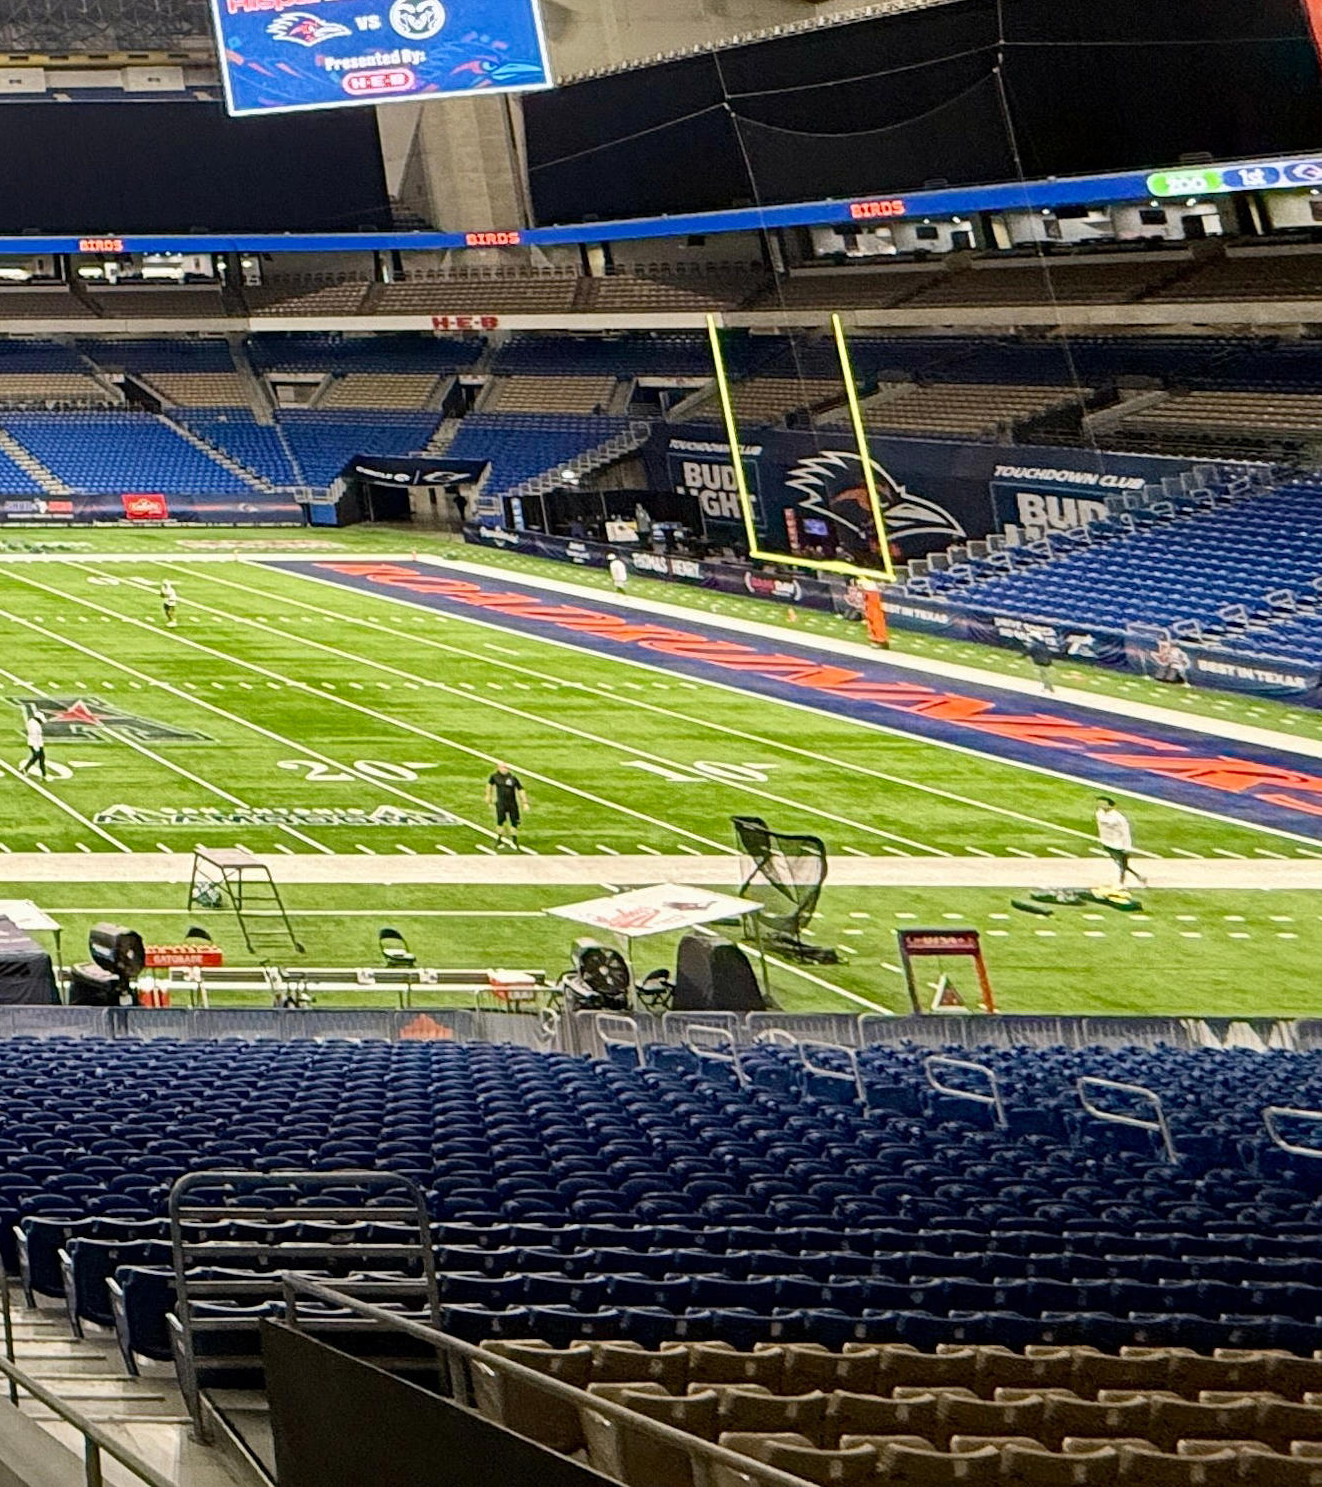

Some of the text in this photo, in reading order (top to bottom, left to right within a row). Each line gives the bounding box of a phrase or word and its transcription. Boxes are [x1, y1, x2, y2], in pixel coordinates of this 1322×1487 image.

[325, 51, 398, 71] Presented
[851, 200, 906, 218] BIRDS
[79, 239, 123, 252] BIRDS
[466, 232, 520, 246] BIRDS
[683, 461, 738, 491] BUD
[994, 465, 1145, 489] TOUCHDOWN CLUB
[276, 759, 419, 782] 20
